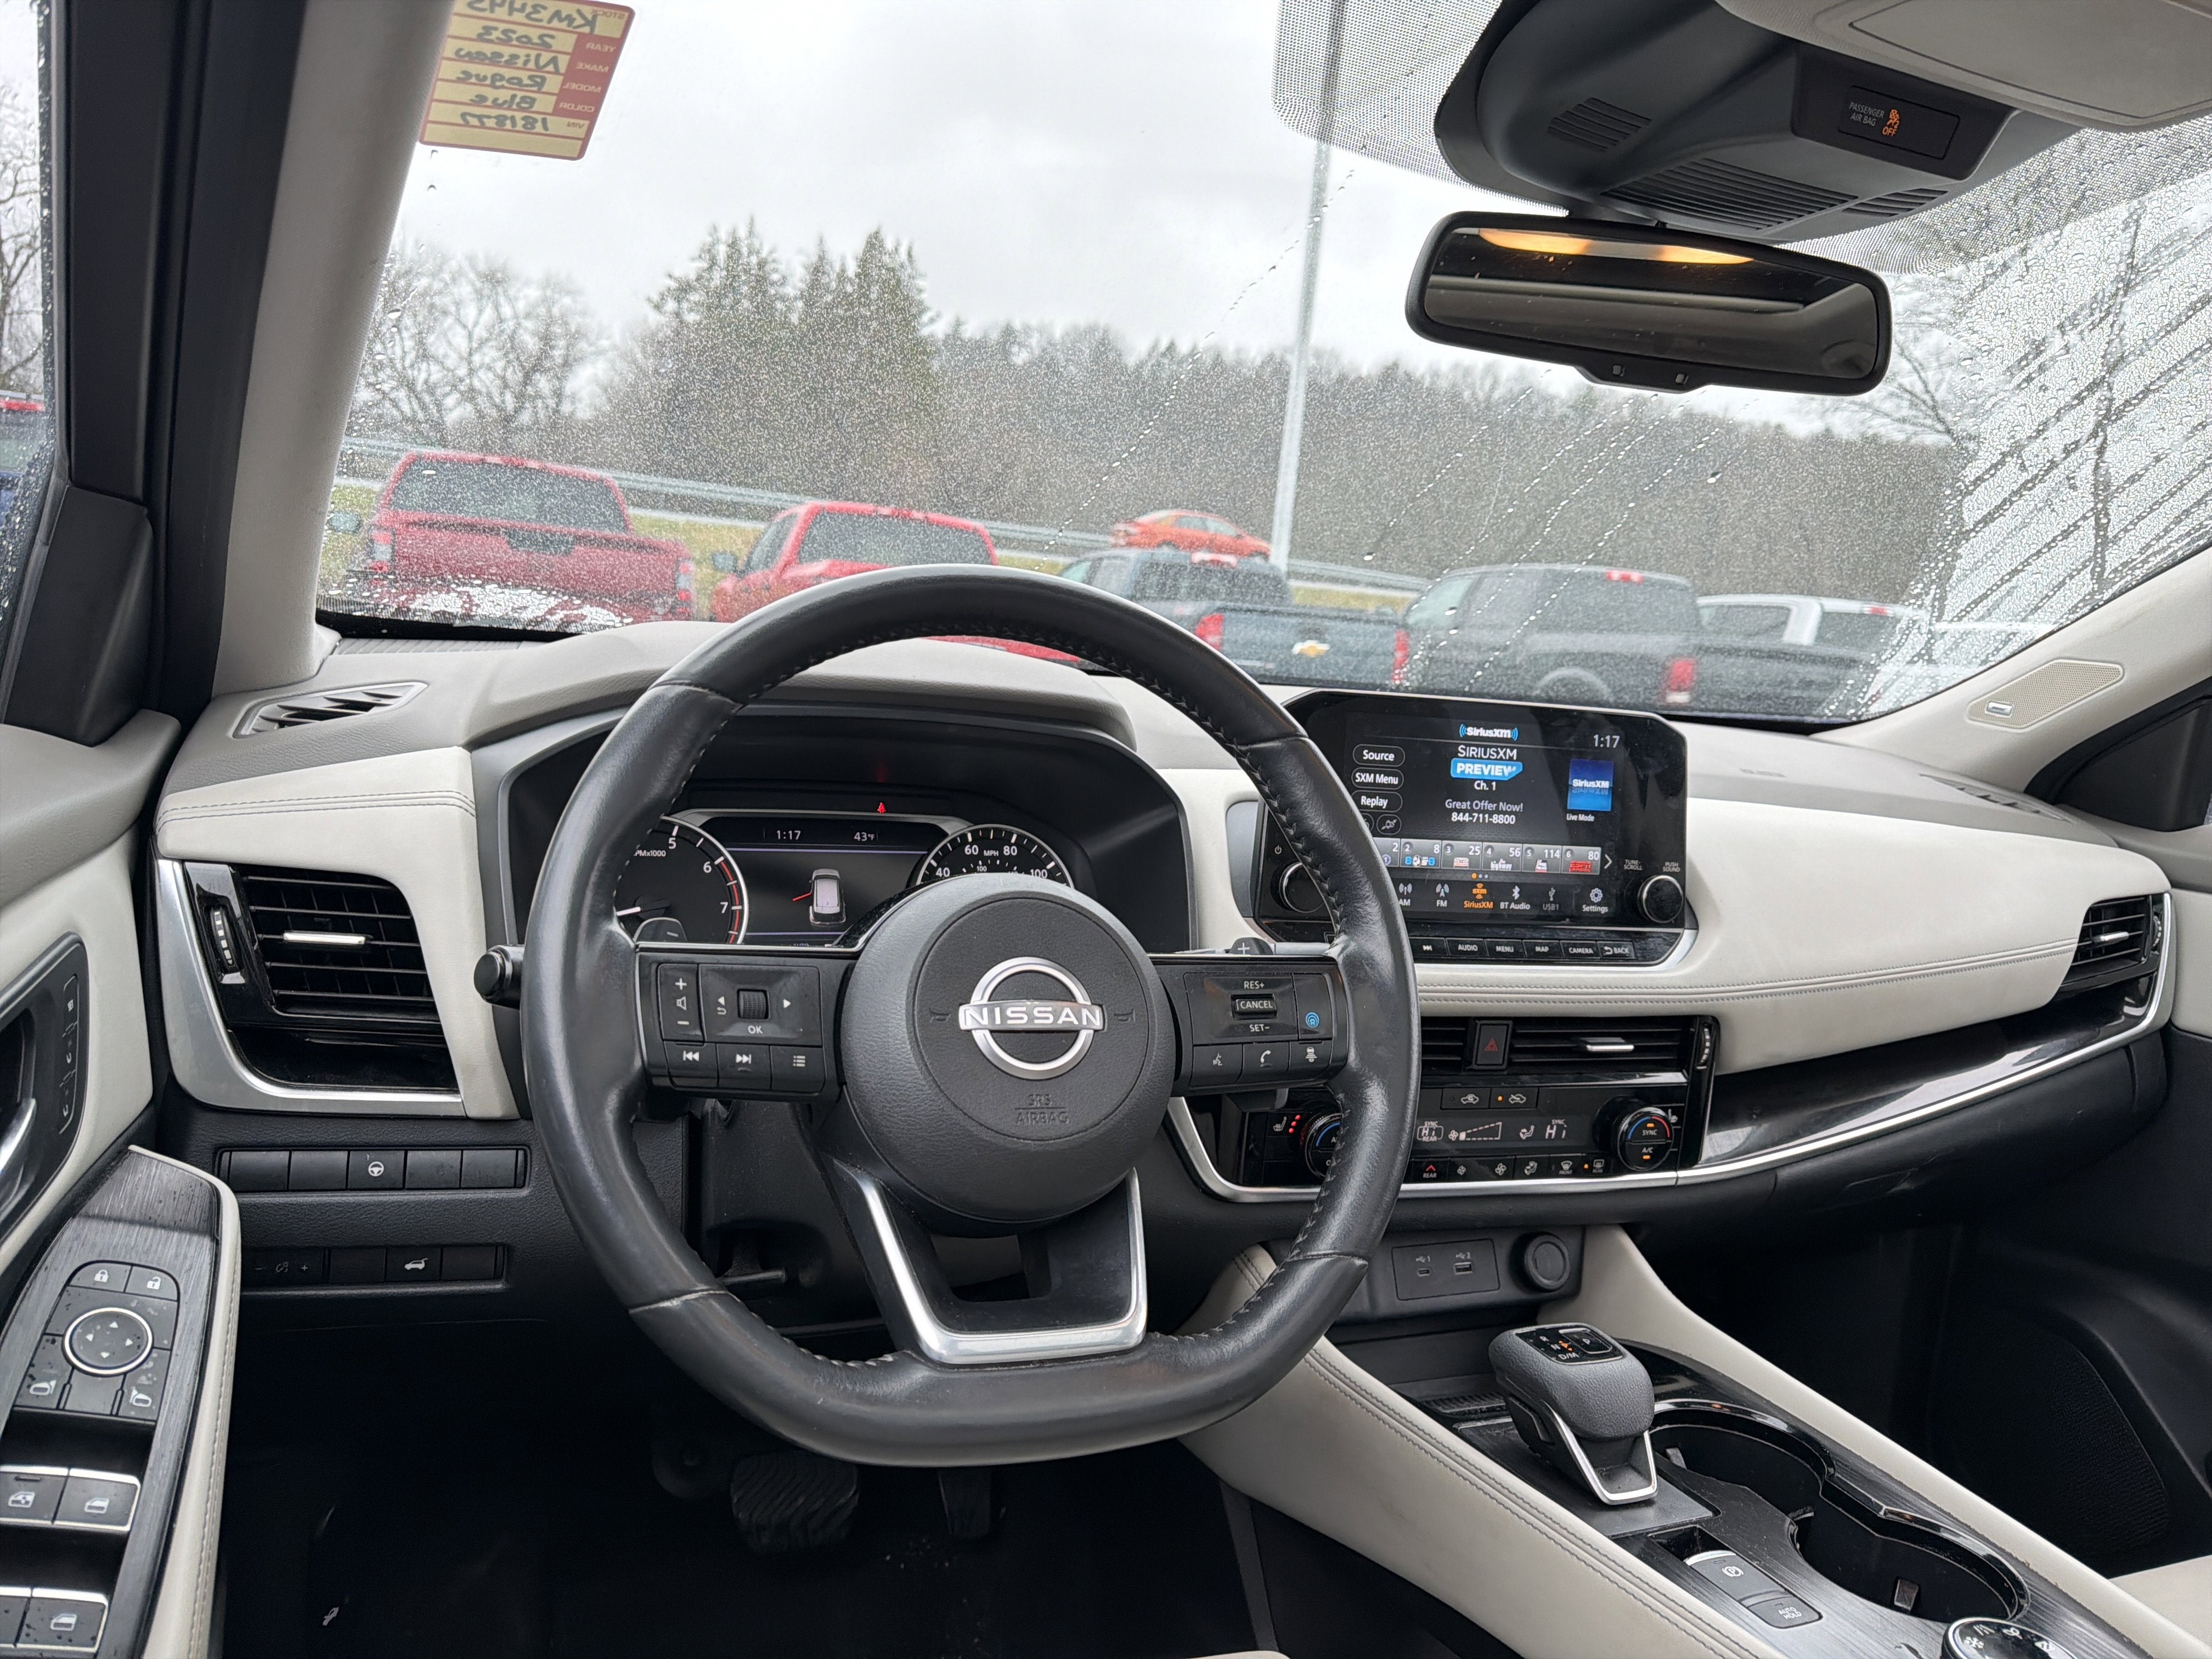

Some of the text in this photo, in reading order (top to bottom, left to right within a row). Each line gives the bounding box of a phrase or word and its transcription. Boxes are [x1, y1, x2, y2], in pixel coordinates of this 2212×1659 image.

[1849, 102, 1884, 119] PASSENGER
[1850, 112, 1876, 127] AIR BAG
[1882, 126, 1897, 137] OFF
[1593, 734, 1620, 748] 1:17
[1363, 749, 1395, 761] Source
[1458, 745, 1517, 760] SIRIUSXM
[1457, 763, 1516, 777] PREVIEW
[1355, 772, 1398, 785] SXM Menu
[1474, 781, 1496, 791] Ch. 1
[1361, 795, 1388, 809] Replay
[1445, 799, 1523, 812] Great Offer Now!
[1452, 812, 1516, 824] 844-711-8800
[776, 830, 801, 840] 1:17
[854, 832, 875, 842] 43°F
[668, 838, 676, 849] 5
[1392, 843, 1398, 852] 2
[965, 845, 978, 855] 60
[1003, 845, 1017, 856] 80
[1405, 844, 1440, 854] 2 8
[1469, 845, 1480, 855] 25
[1509, 848, 1521, 857] 56
[1544, 849, 1560, 859] 114
[1588, 851, 1599, 860] 80
[703, 861, 712, 873] 6
[936, 867, 950, 877] 40
[1030, 868, 1048, 878] 100
[720, 902, 728, 913] 7
[1464, 900, 1493, 909] SiriusXM
[1510, 902, 1530, 910] Audio
[1582, 905, 1609, 913] Settings
[1240, 1000, 1273, 1009] CANCEL
[966, 1006, 1101, 1026] NISSAN
[748, 1025, 763, 1034] OK
[1017, 1111, 1070, 1125] AIRBAG
[1545, 1125, 1567, 1139] Hi
[1778, 1607, 1797, 1615] AUTO
